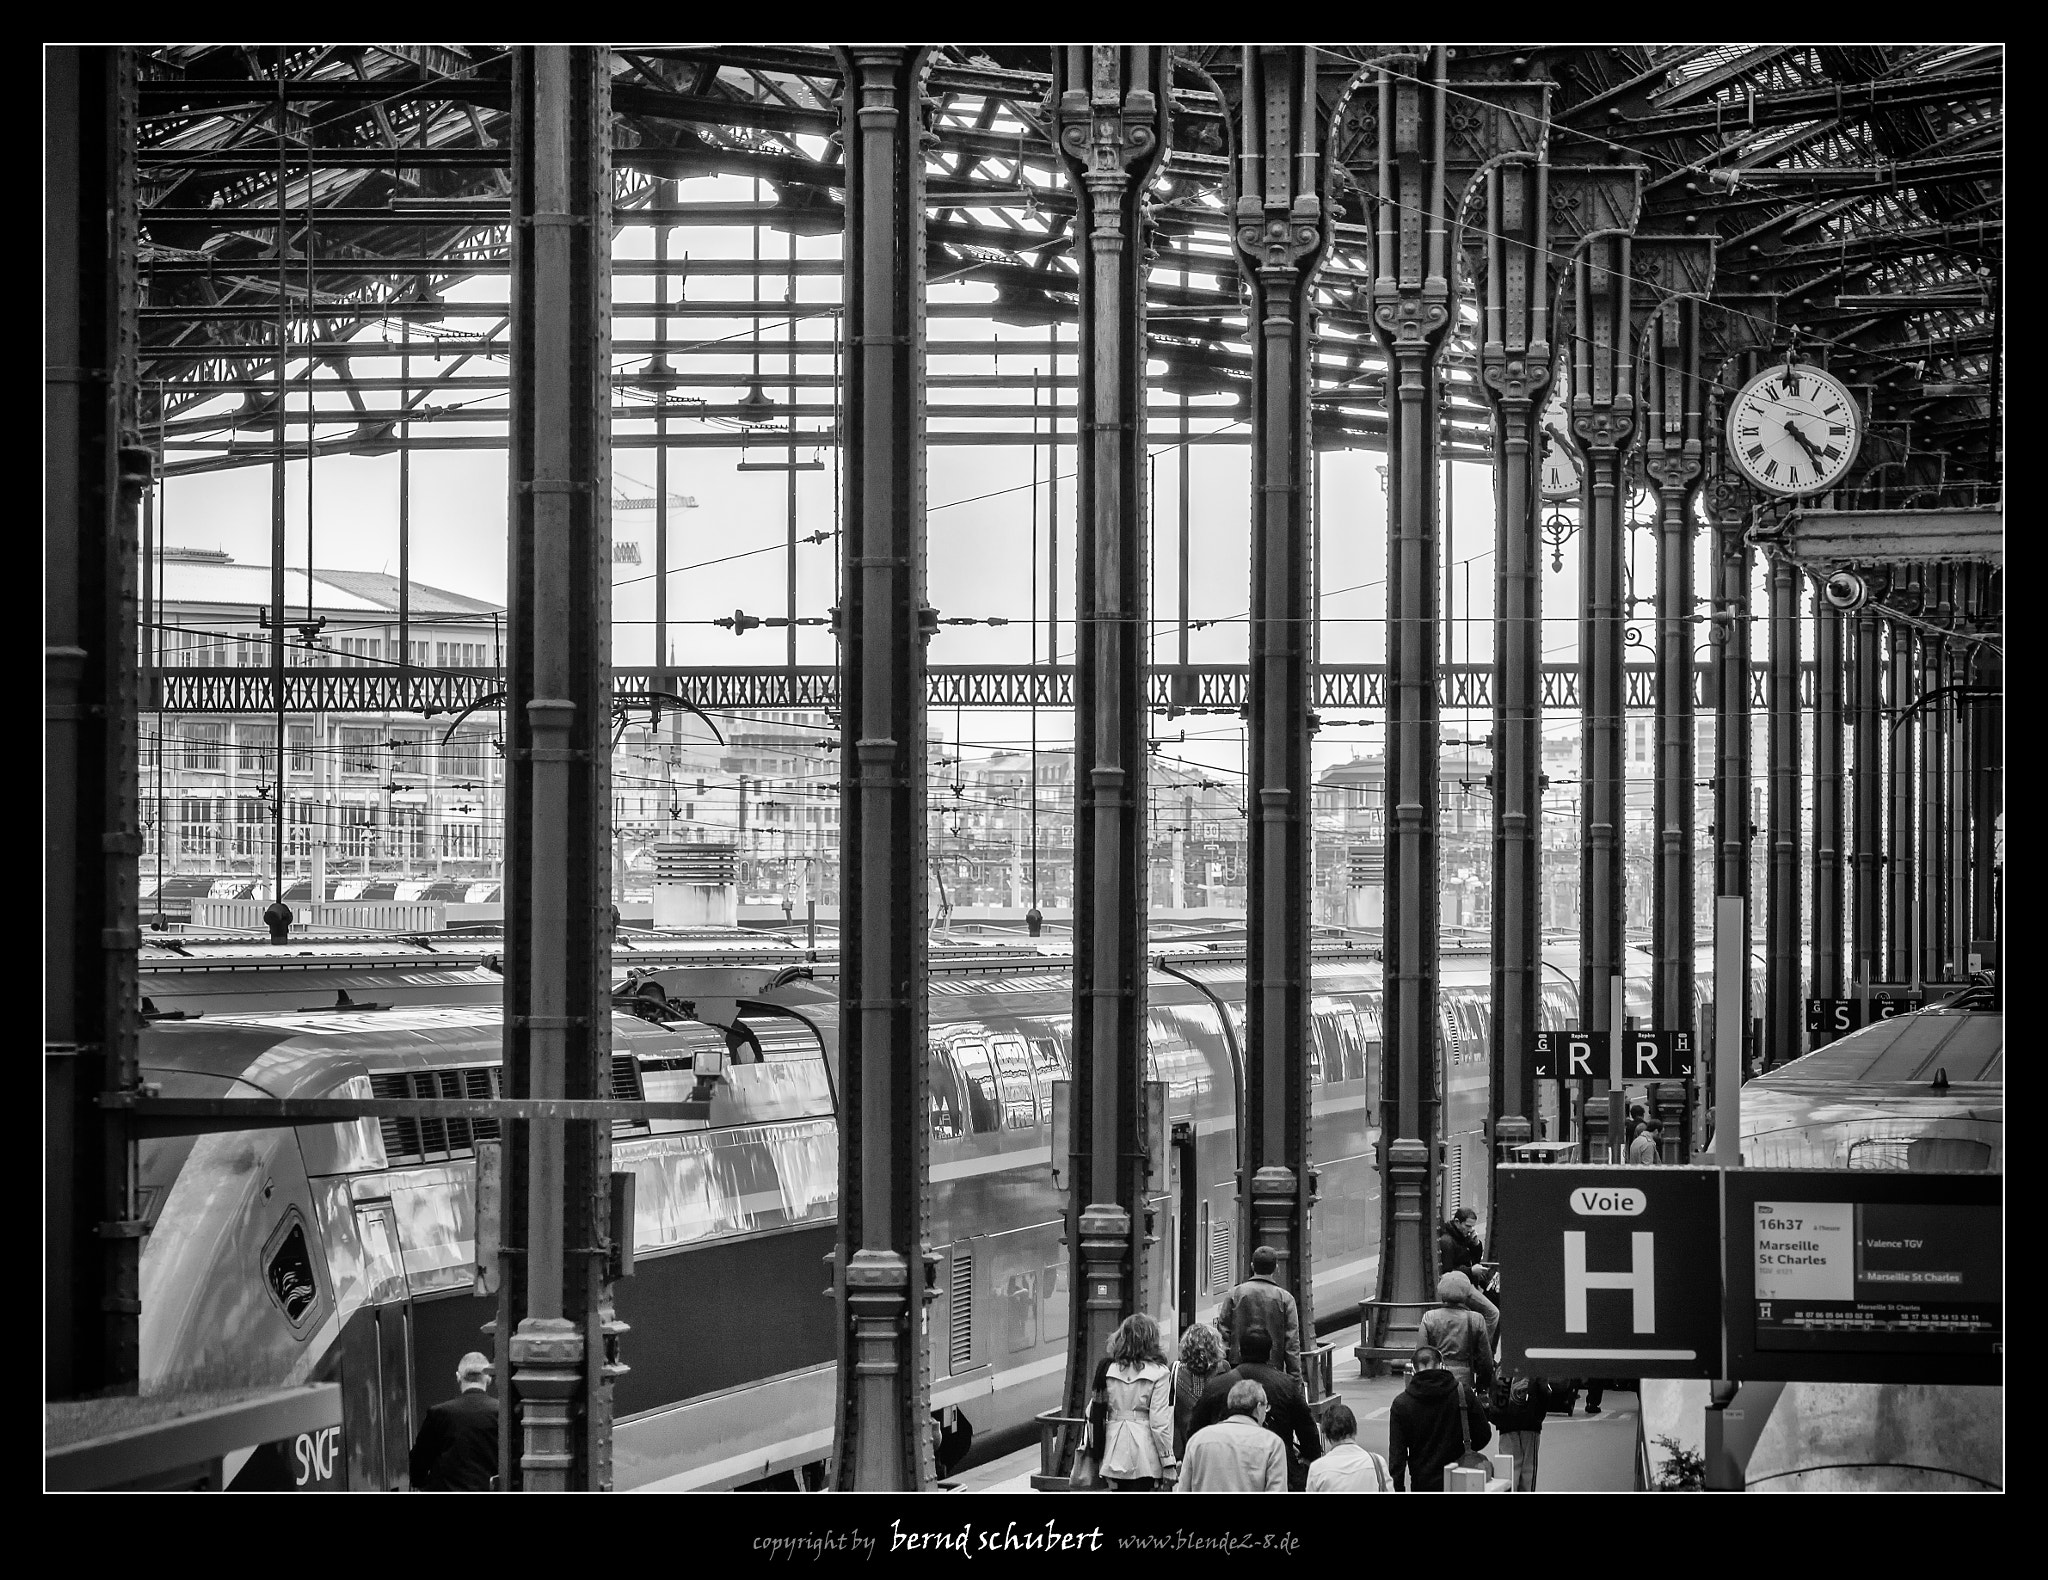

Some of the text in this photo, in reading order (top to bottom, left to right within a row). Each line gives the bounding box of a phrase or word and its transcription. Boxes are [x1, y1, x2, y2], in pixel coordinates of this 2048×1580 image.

[1814, 1004, 1821, 1012] G
[1835, 1006, 1850, 1030] S
[1538, 1039, 1547, 1050] G
[1678, 1038, 1688, 1049] H
[1569, 1042, 1593, 1075] R
[1636, 1042, 1660, 1075] R
[1582, 1192, 1634, 1211] Voie
[1760, 1219, 1803, 1230] 16h37
[1760, 1240, 1819, 1251] Marseille
[1867, 1239, 1923, 1248] Valence TGV
[1760, 1253, 1827, 1265] St Charles
[1564, 1231, 1655, 1333] H
[1867, 1272, 1960, 1282] Marseille St Charles
[1761, 1307, 1771, 1317] H
[295, 1426, 341, 1485] SNCF
